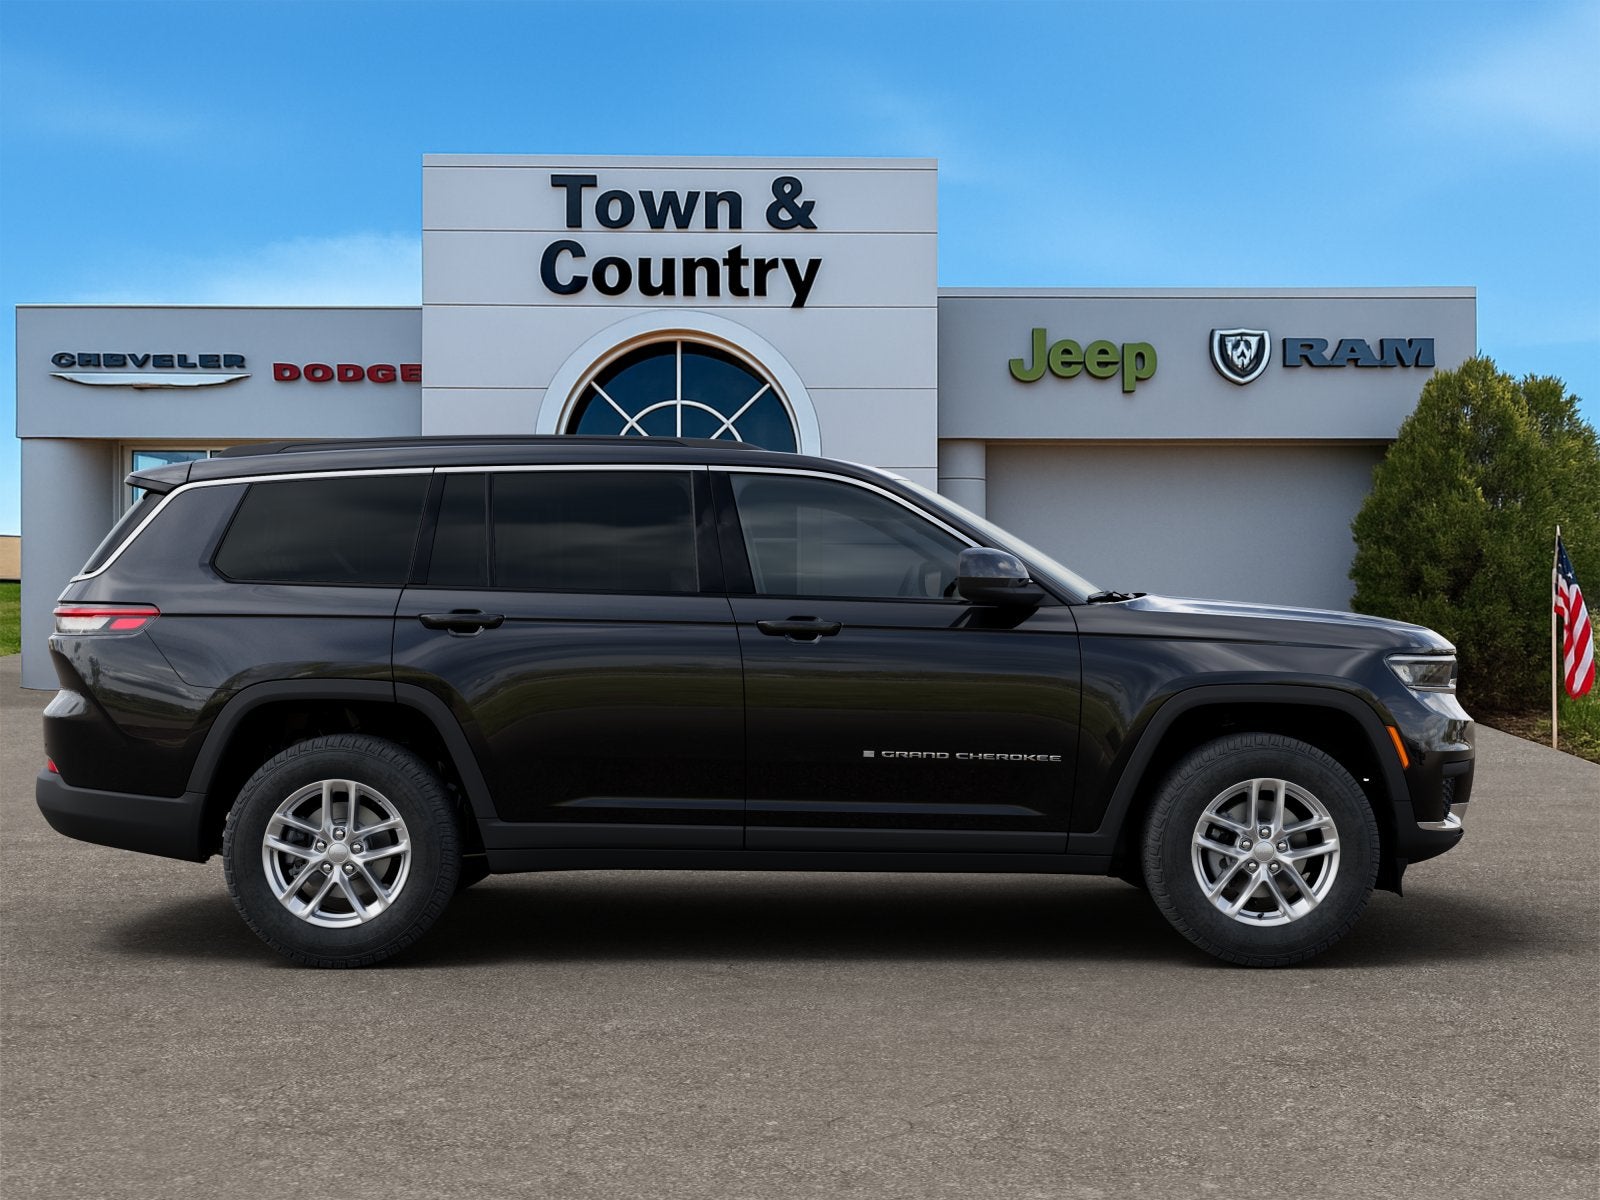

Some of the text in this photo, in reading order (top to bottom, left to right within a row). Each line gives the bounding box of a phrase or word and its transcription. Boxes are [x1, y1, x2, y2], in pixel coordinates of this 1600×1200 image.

[550, 174, 818, 230] Town &
[540, 239, 822, 308] Country
[273, 363, 422, 383] DODGE
[1009, 328, 1157, 393] Jeep
[1282, 337, 1435, 368] RAM
[881, 751, 1063, 762] GRAND CHEROKEE
